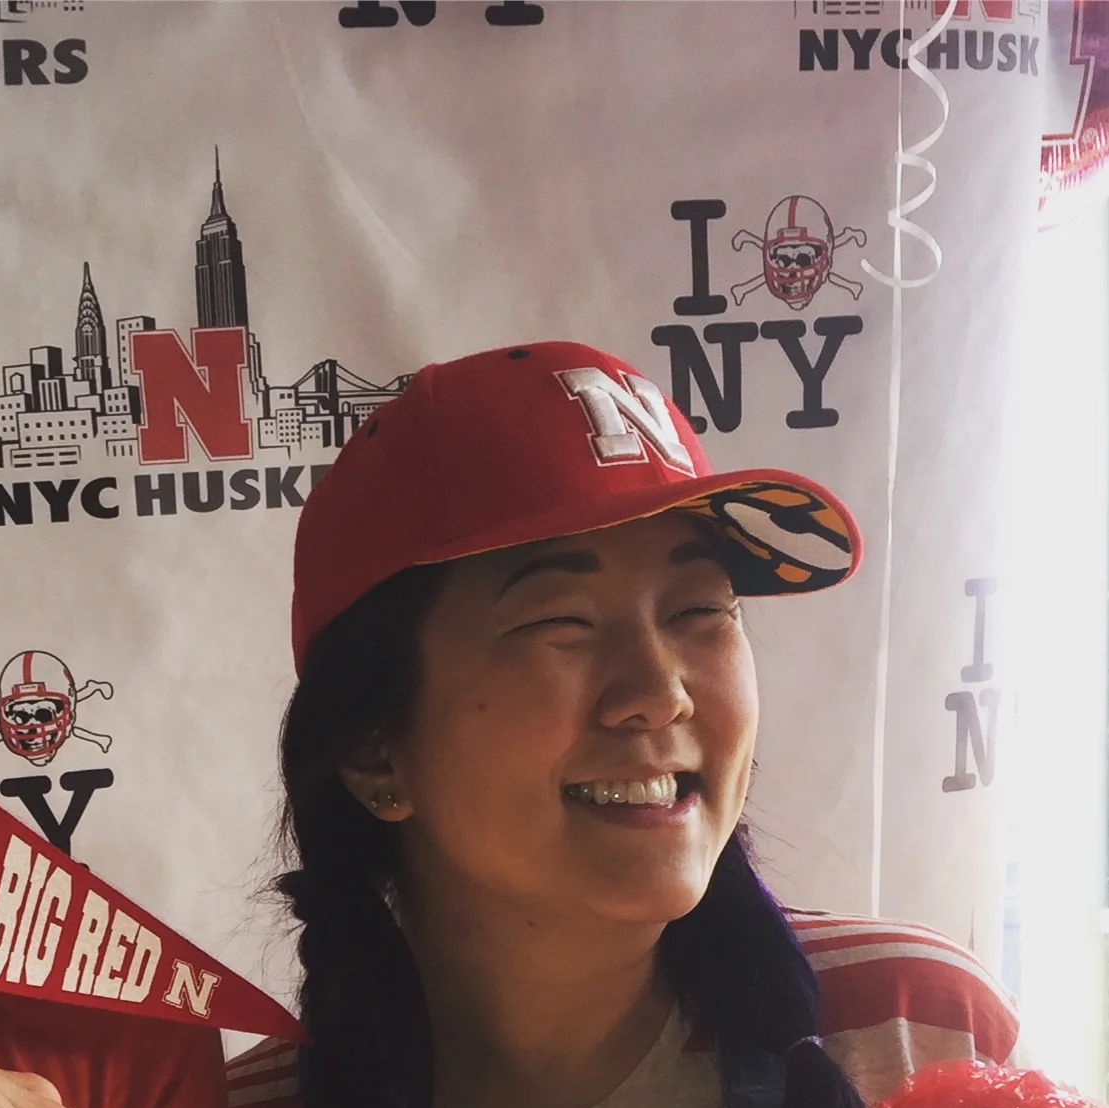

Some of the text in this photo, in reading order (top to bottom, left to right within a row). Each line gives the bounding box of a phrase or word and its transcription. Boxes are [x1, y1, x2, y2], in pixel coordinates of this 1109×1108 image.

[799, 28, 912, 72] NYC
[671, 199, 728, 316] I
[128, 326, 254, 466] N
[553, 366, 698, 478] N
[651, 315, 863, 434] NY
[960, 577, 998, 683] I
[61, 889, 163, 1003] RED
[162, 958, 222, 1019] N
